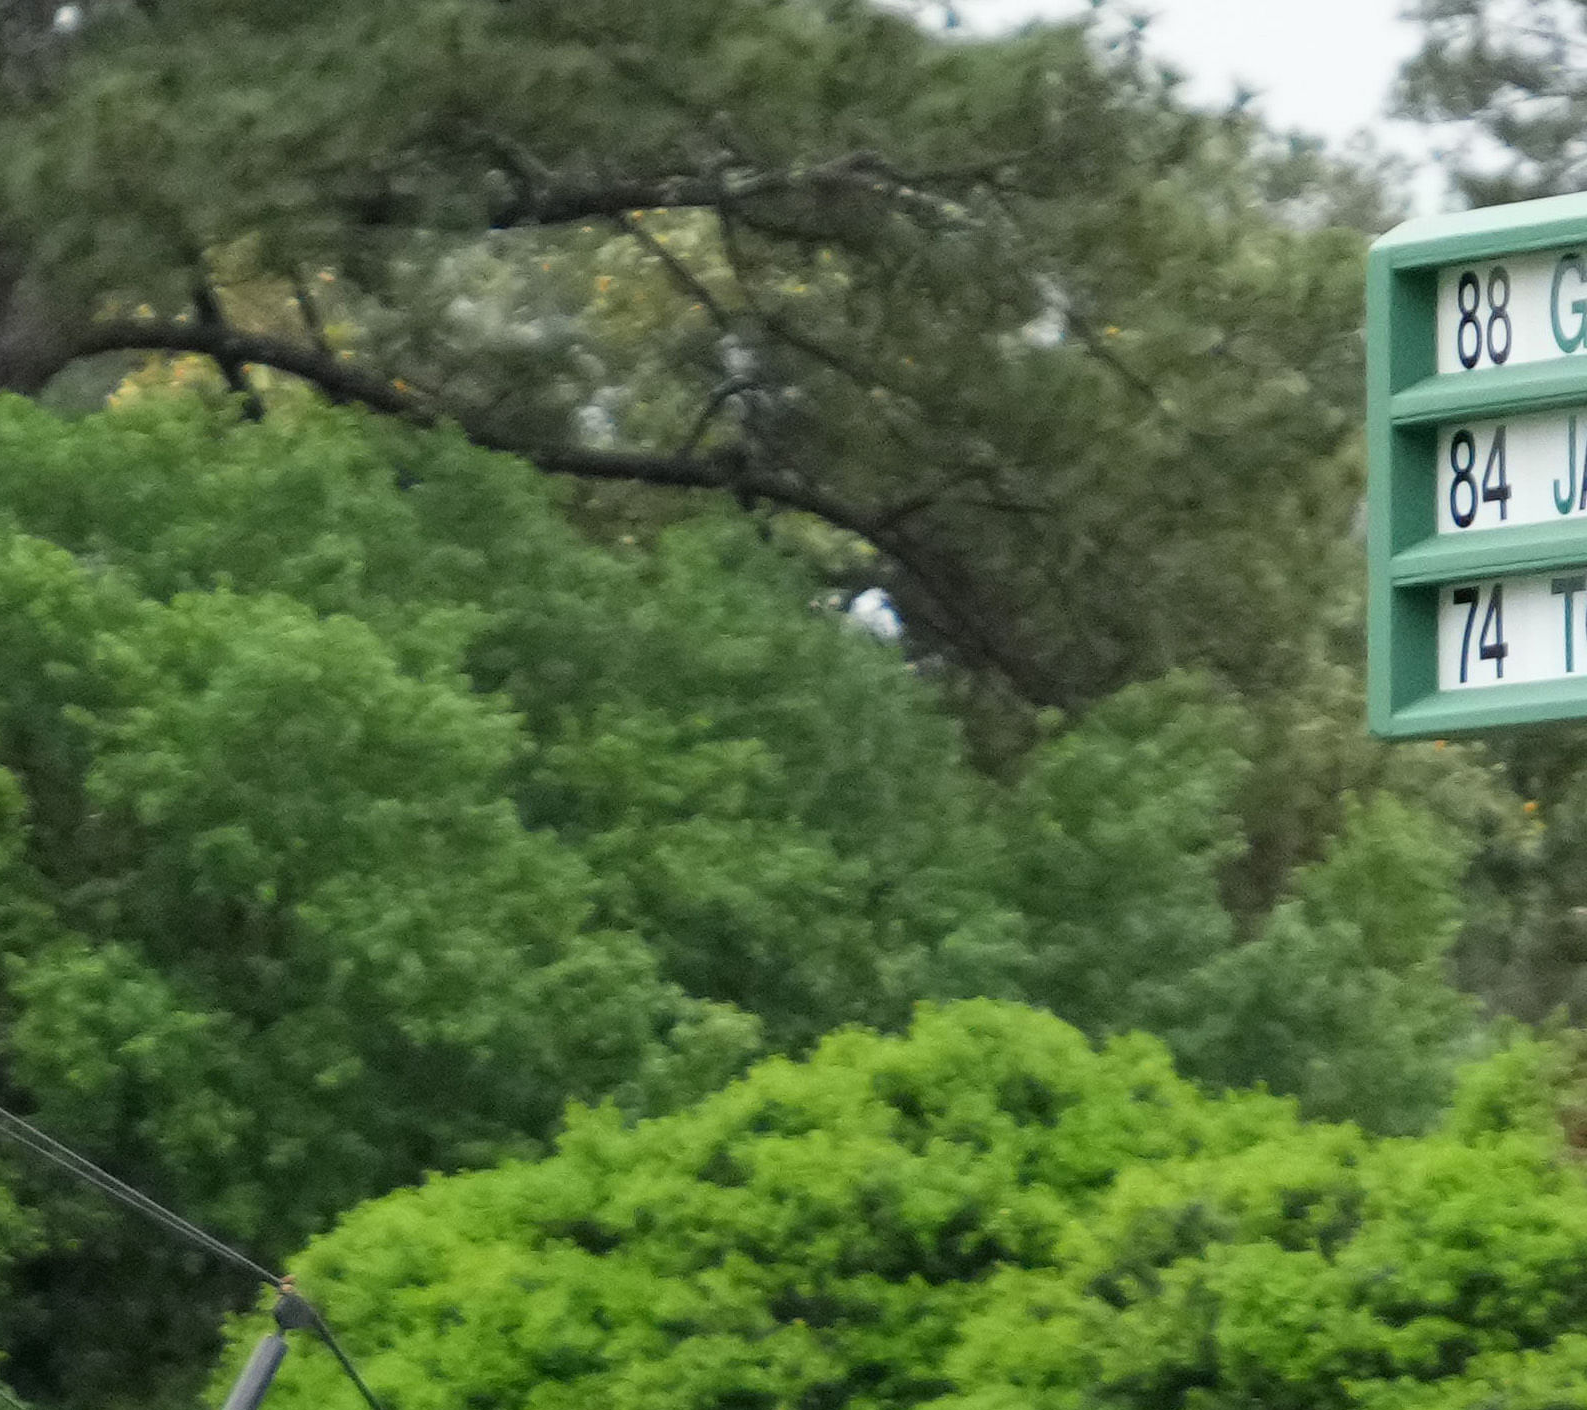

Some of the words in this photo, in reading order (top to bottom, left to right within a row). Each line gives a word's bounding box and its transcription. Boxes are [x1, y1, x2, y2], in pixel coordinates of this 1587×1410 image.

[1456, 264, 1513, 371] 88
[1449, 425, 1513, 529] 84
[1452, 582, 1510, 684] 74
